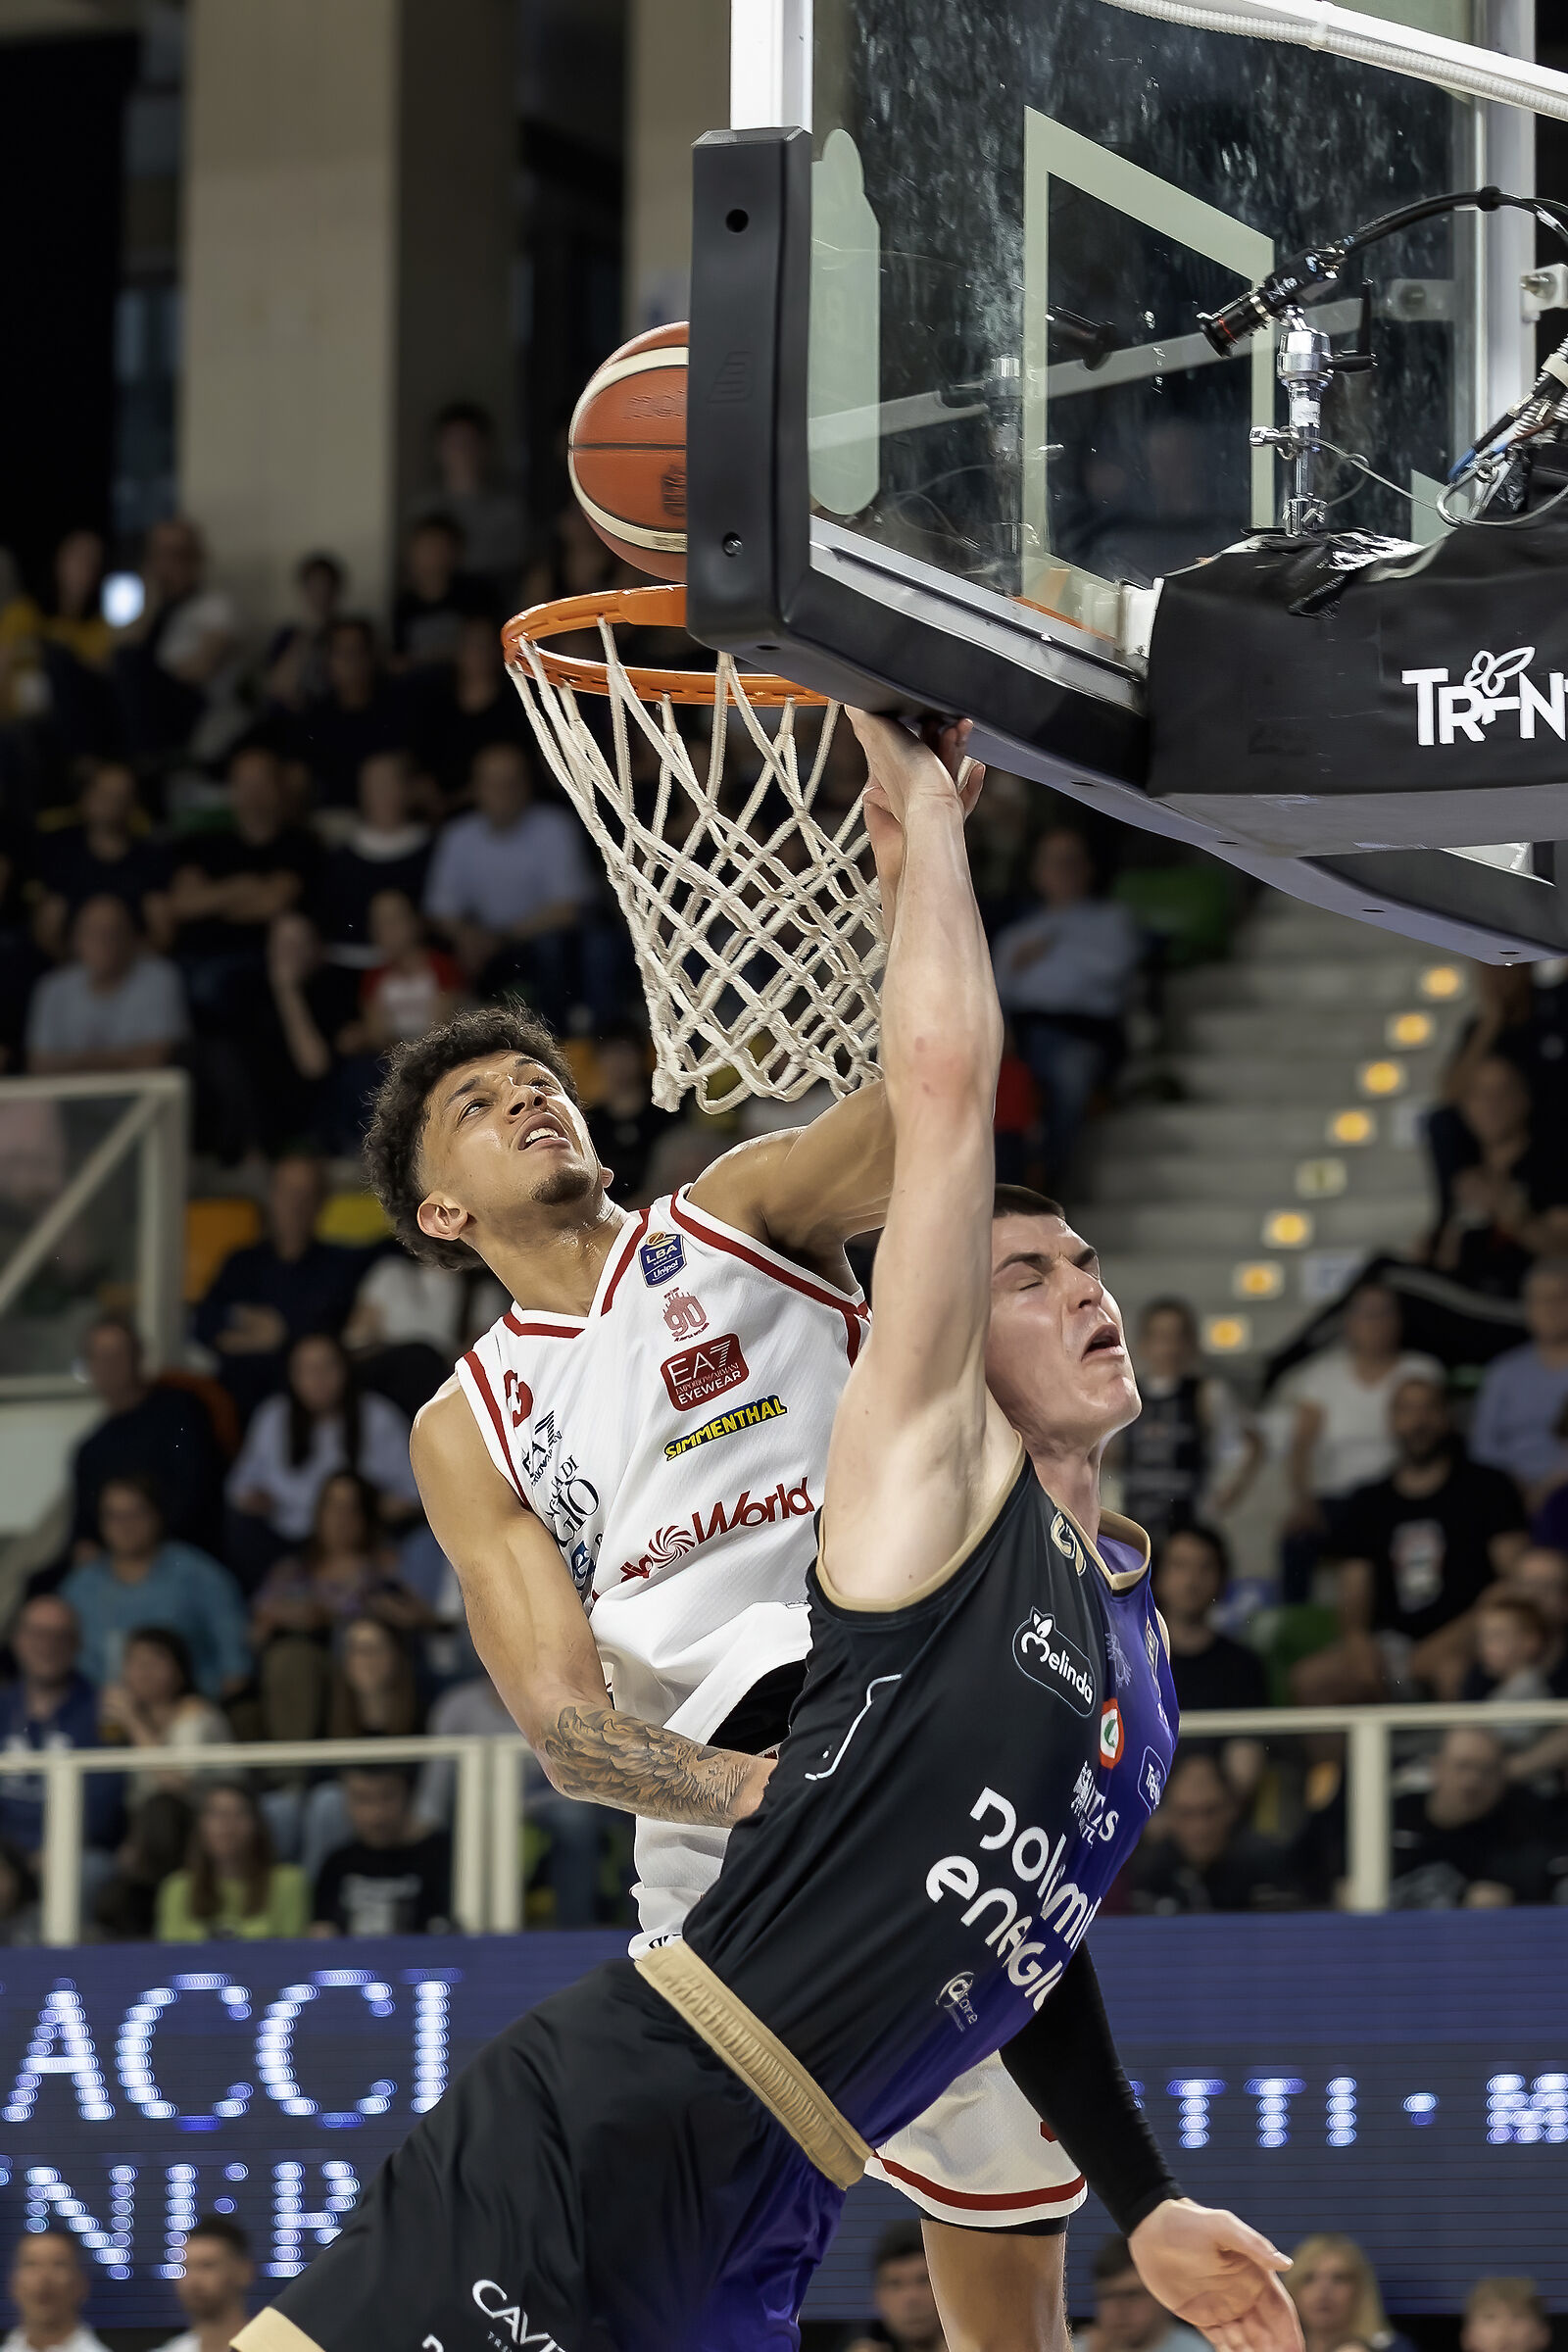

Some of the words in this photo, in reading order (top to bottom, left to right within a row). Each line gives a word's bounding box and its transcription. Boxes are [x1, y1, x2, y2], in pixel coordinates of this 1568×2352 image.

[646, 1244, 678, 1264] LBA
[653, 1259, 679, 1278] Unipol
[666, 1339, 731, 1387] EA7
[678, 1369, 742, 1405] EYEWEAR
[664, 1397, 787, 1461] SIMMENTHAL
[691, 1476, 815, 1545] World
[1020, 1630, 1094, 1705] Melinda
